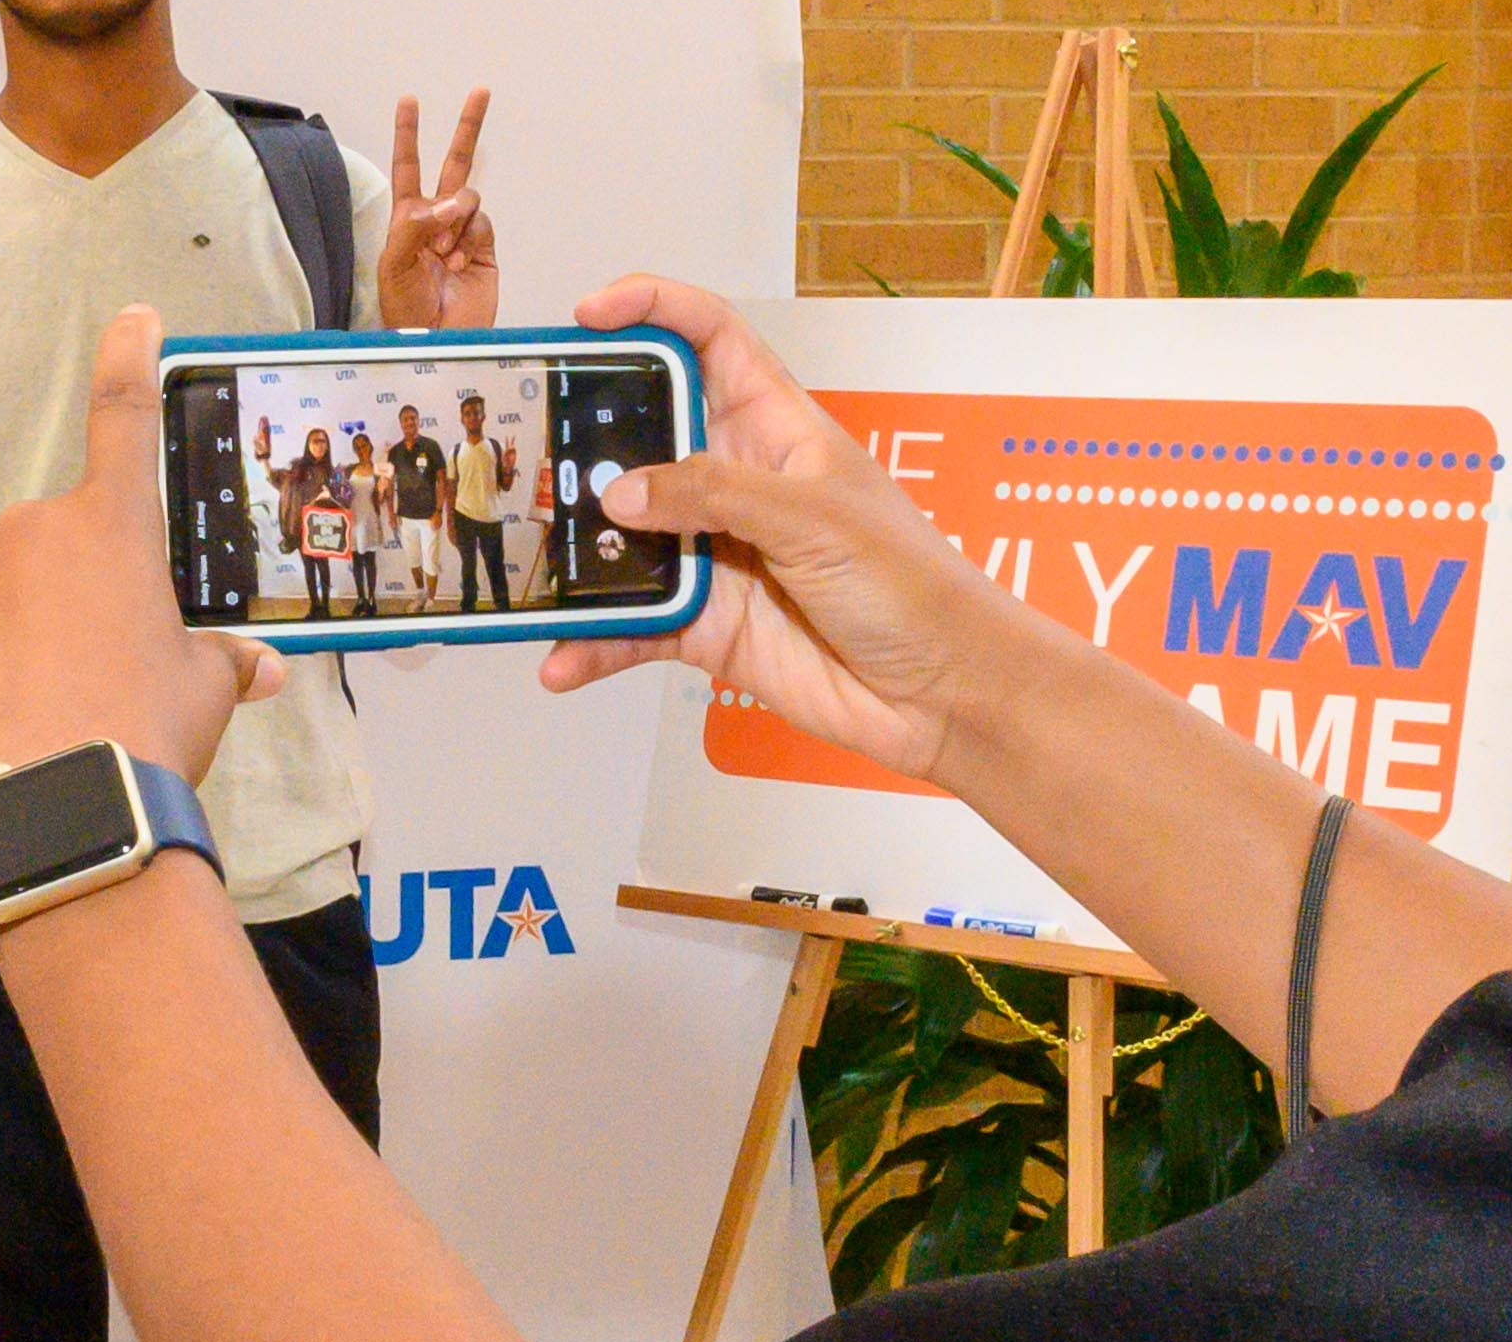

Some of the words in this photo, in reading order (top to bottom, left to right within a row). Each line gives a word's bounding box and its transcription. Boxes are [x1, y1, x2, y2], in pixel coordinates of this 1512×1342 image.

[376, 392, 397, 403] UTA
[498, 413, 522, 424] UTA
[1163, 544, 1469, 670] MAV
[357, 865, 576, 967] UTA
